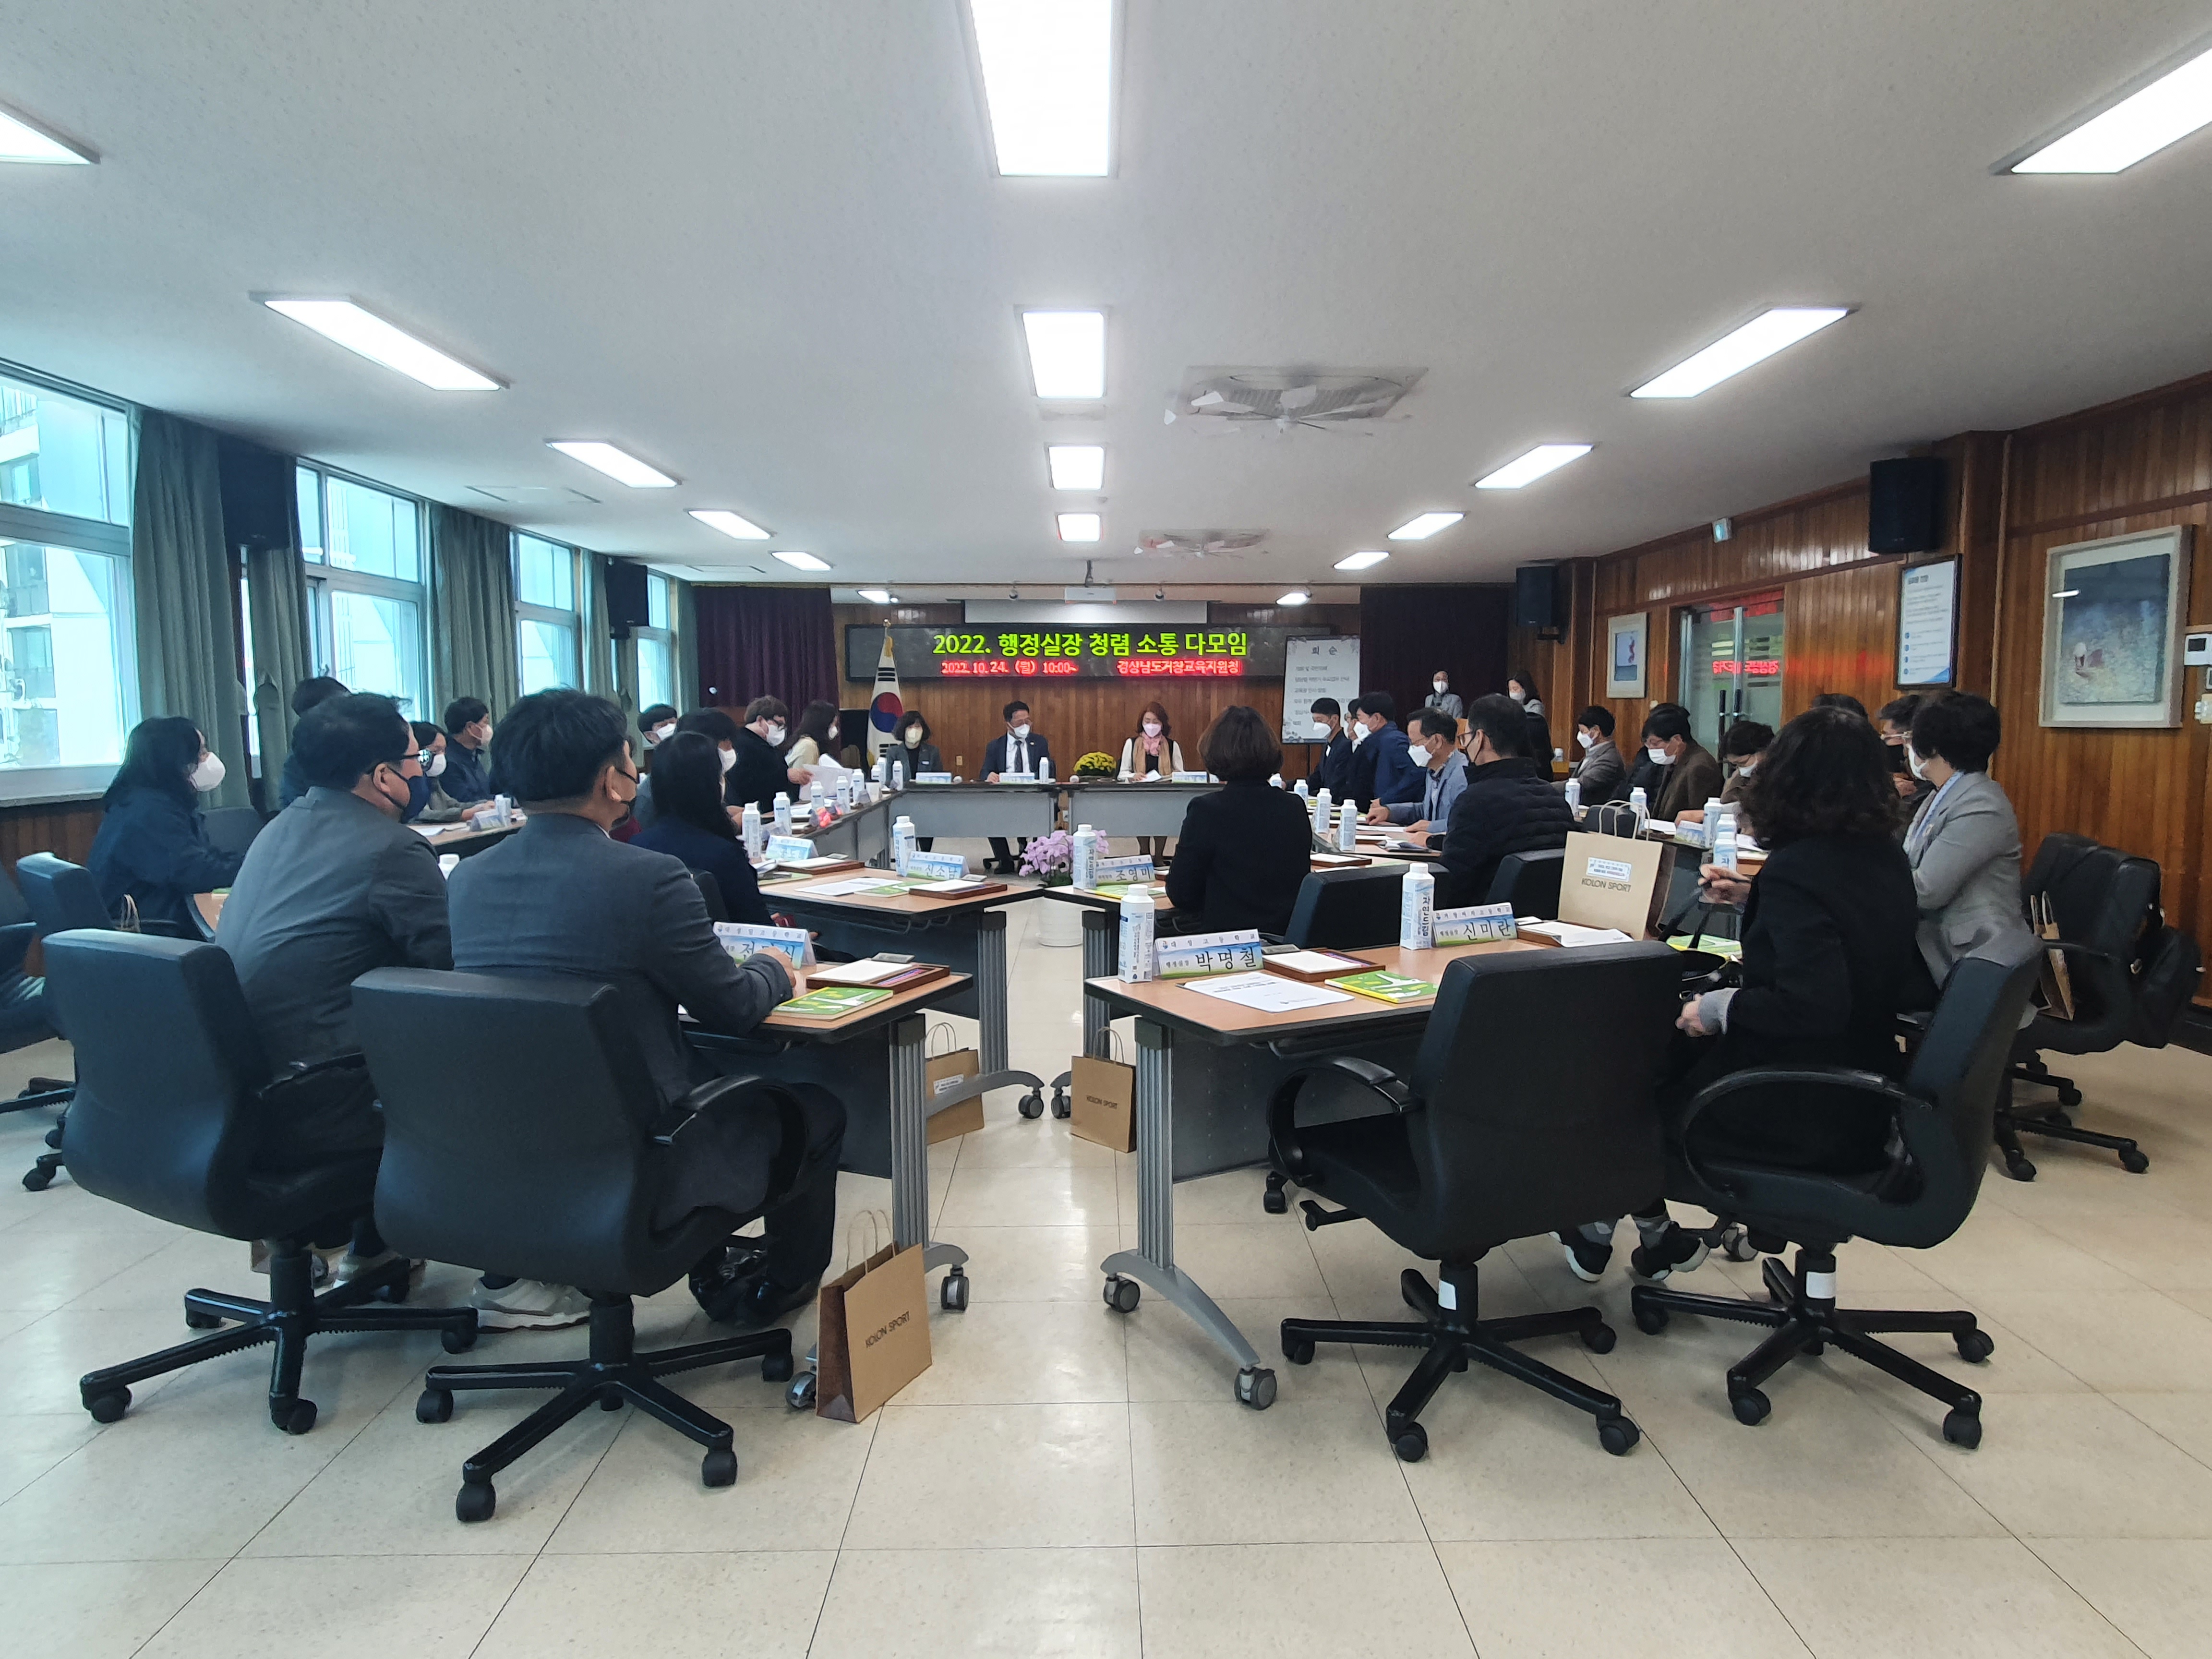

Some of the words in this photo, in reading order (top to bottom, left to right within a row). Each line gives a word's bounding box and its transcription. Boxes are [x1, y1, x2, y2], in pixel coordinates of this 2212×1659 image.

[933, 634, 992, 654] 2022.
[998, 633, 1083, 657] 행정실장
[1088, 632, 1130, 656] 청렴
[1136, 632, 1179, 656] 소통
[1185, 632, 1247, 656] 다모임
[1115, 865, 1151, 882] 조영미
[1581, 878, 1606, 889] KOLON
[1608, 881, 1632, 892] SPORT
[1463, 918, 1512, 941] 신미란
[1195, 946, 1257, 973] 박명철
[865, 1324, 887, 1348] KOLON
[888, 1310, 910, 1332] SPORT
